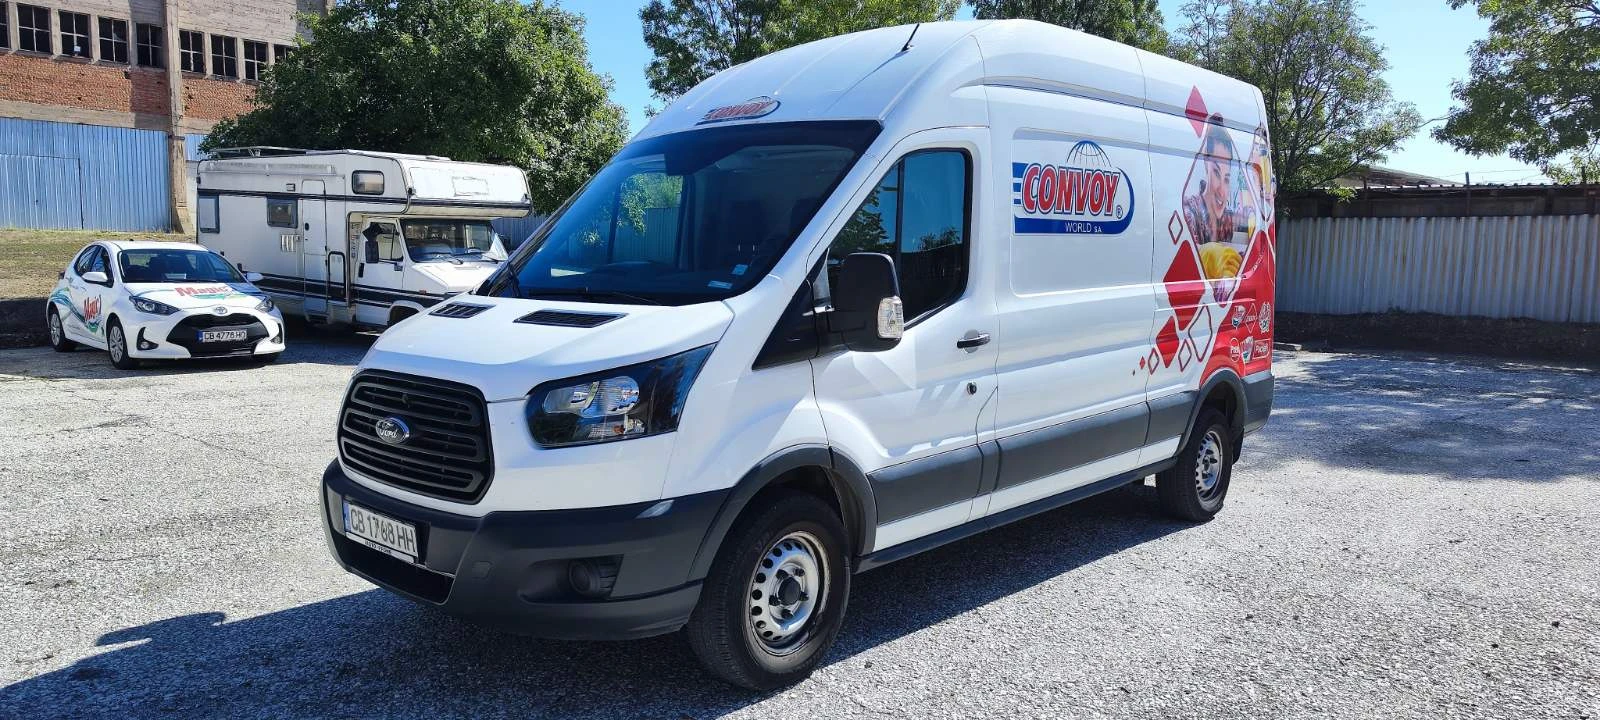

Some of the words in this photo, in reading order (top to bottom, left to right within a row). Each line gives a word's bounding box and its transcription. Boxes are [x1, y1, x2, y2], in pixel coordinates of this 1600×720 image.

[703, 101, 775, 120] CONVOY
[1022, 163, 1121, 216] CONVOY
[1065, 222, 1092, 233] WORLD
[351, 508, 366, 534] CB
[396, 525, 416, 553] HH
